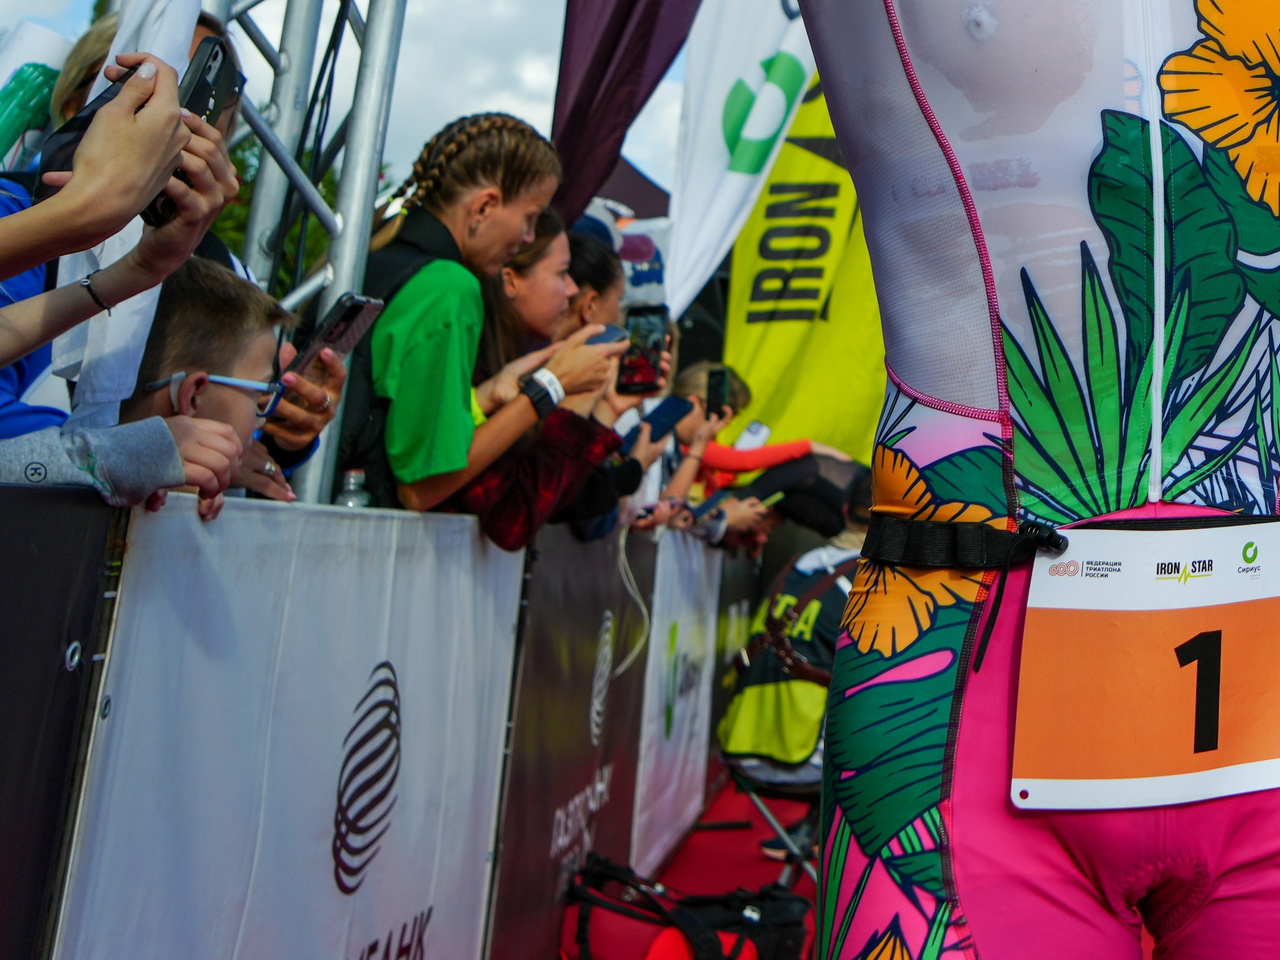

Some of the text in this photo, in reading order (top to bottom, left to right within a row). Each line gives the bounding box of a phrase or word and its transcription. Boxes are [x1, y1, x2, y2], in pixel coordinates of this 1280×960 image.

[746, 181, 840, 325] IRON
[1156, 559, 1214, 576] IRON STAR
[1237, 565, 1261, 574] Сириус
[1174, 629, 1223, 754] 1
